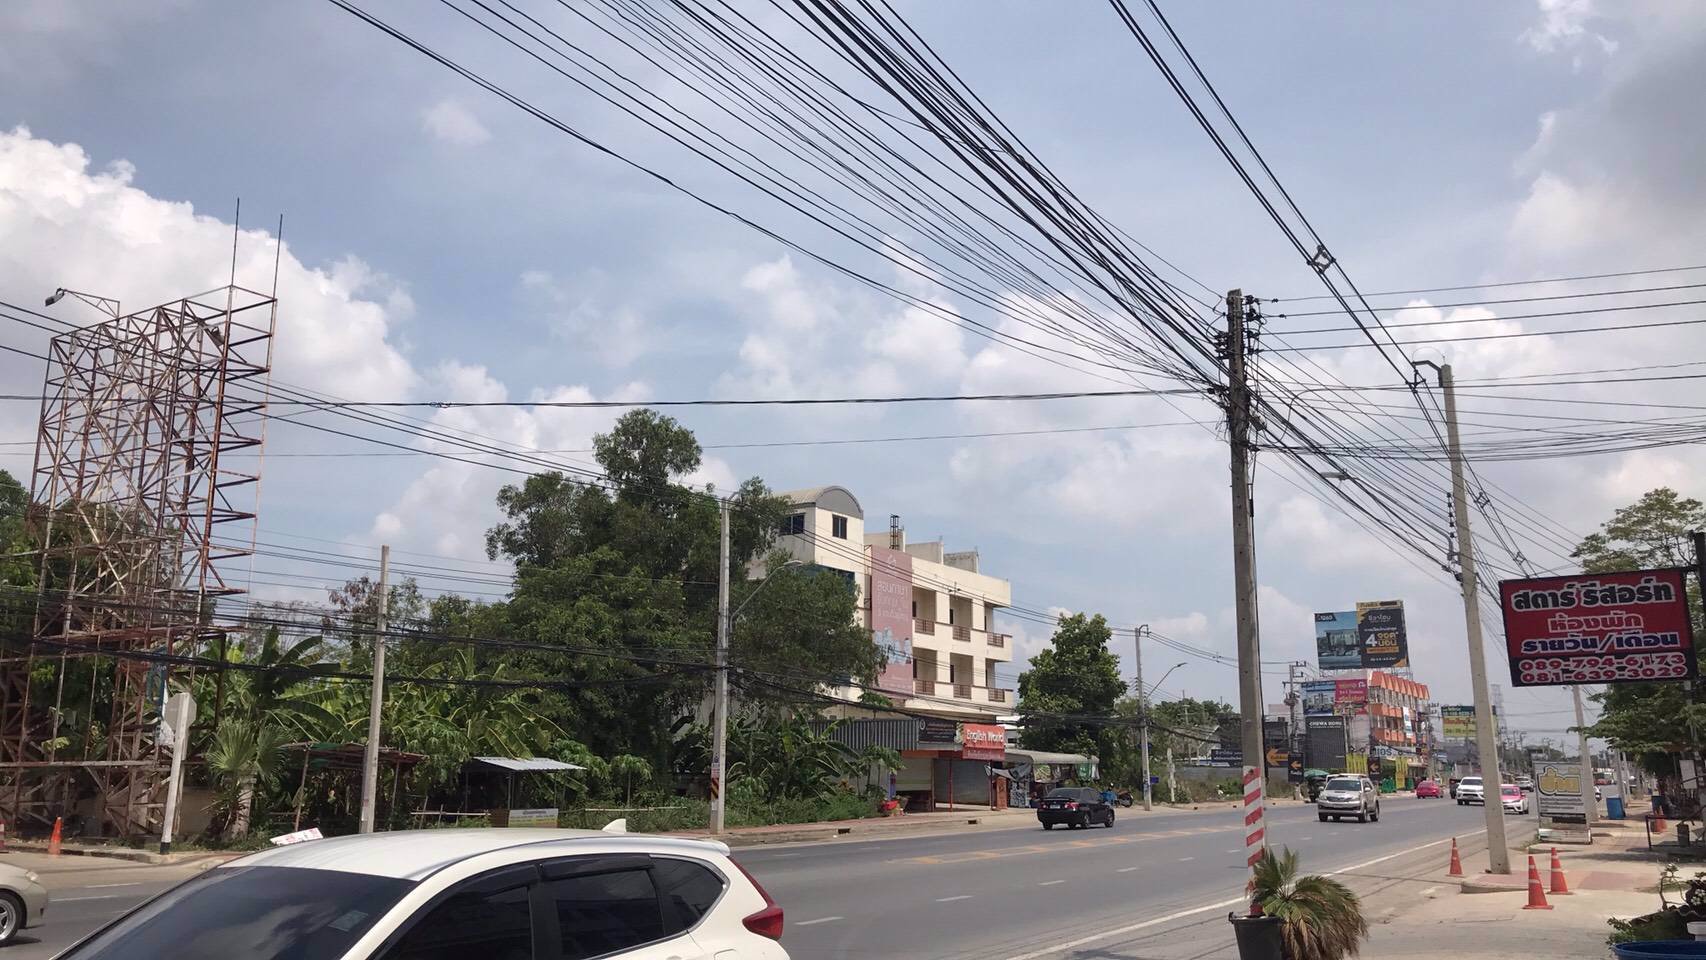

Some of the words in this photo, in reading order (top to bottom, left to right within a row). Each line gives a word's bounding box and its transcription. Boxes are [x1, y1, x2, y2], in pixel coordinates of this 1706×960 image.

[1513, 583, 1578, 611] สตาร์
[1580, 576, 1676, 606] รีสอร์ท
[1548, 609, 1644, 633] ห้องพัก
[1365, 633, 1377, 647] 4
[1521, 629, 1681, 654] รายวัน/เดือน
[1519, 651, 1686, 672] 089-794-6173
[1520, 665, 1688, 684] 081-639-3029
[966, 729, 987, 743] English
[987, 731, 1004, 743] World
